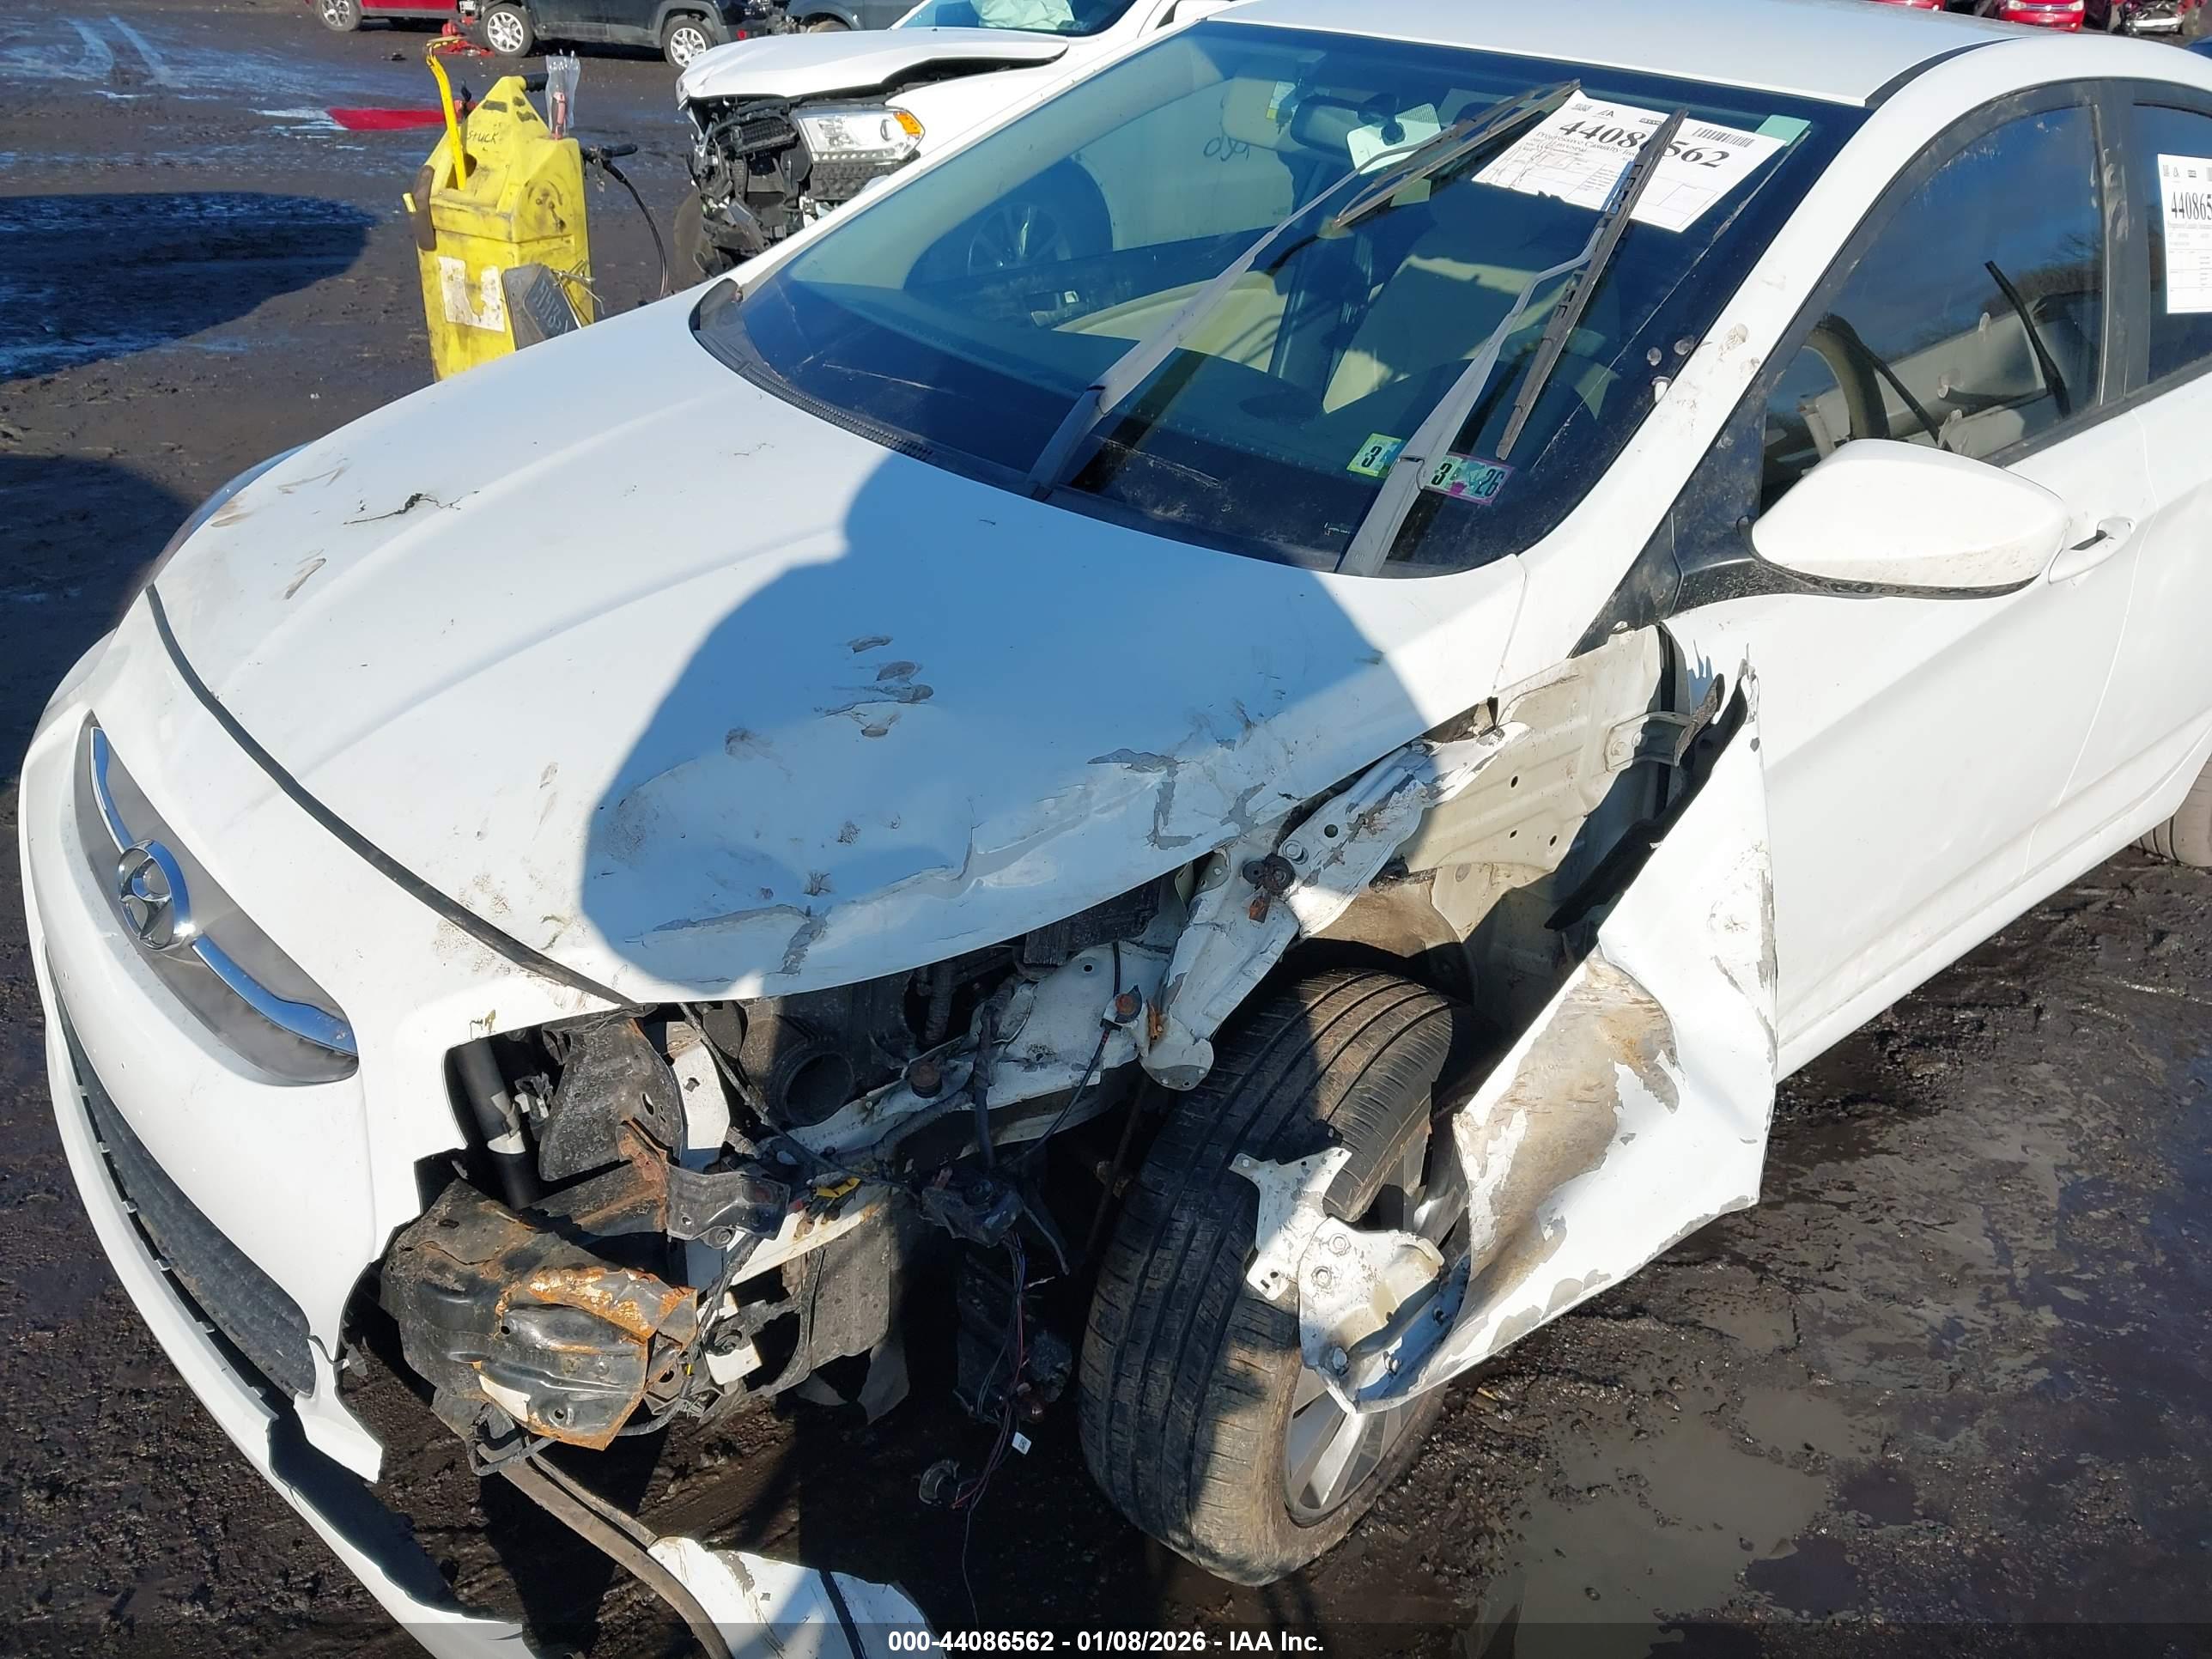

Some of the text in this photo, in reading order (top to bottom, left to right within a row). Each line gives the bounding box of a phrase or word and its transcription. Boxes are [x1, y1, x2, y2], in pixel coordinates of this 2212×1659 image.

[1559, 120, 1730, 167] 4408562
[1361, 446, 1382, 467] 3
[1431, 462, 1505, 496] 3 26
